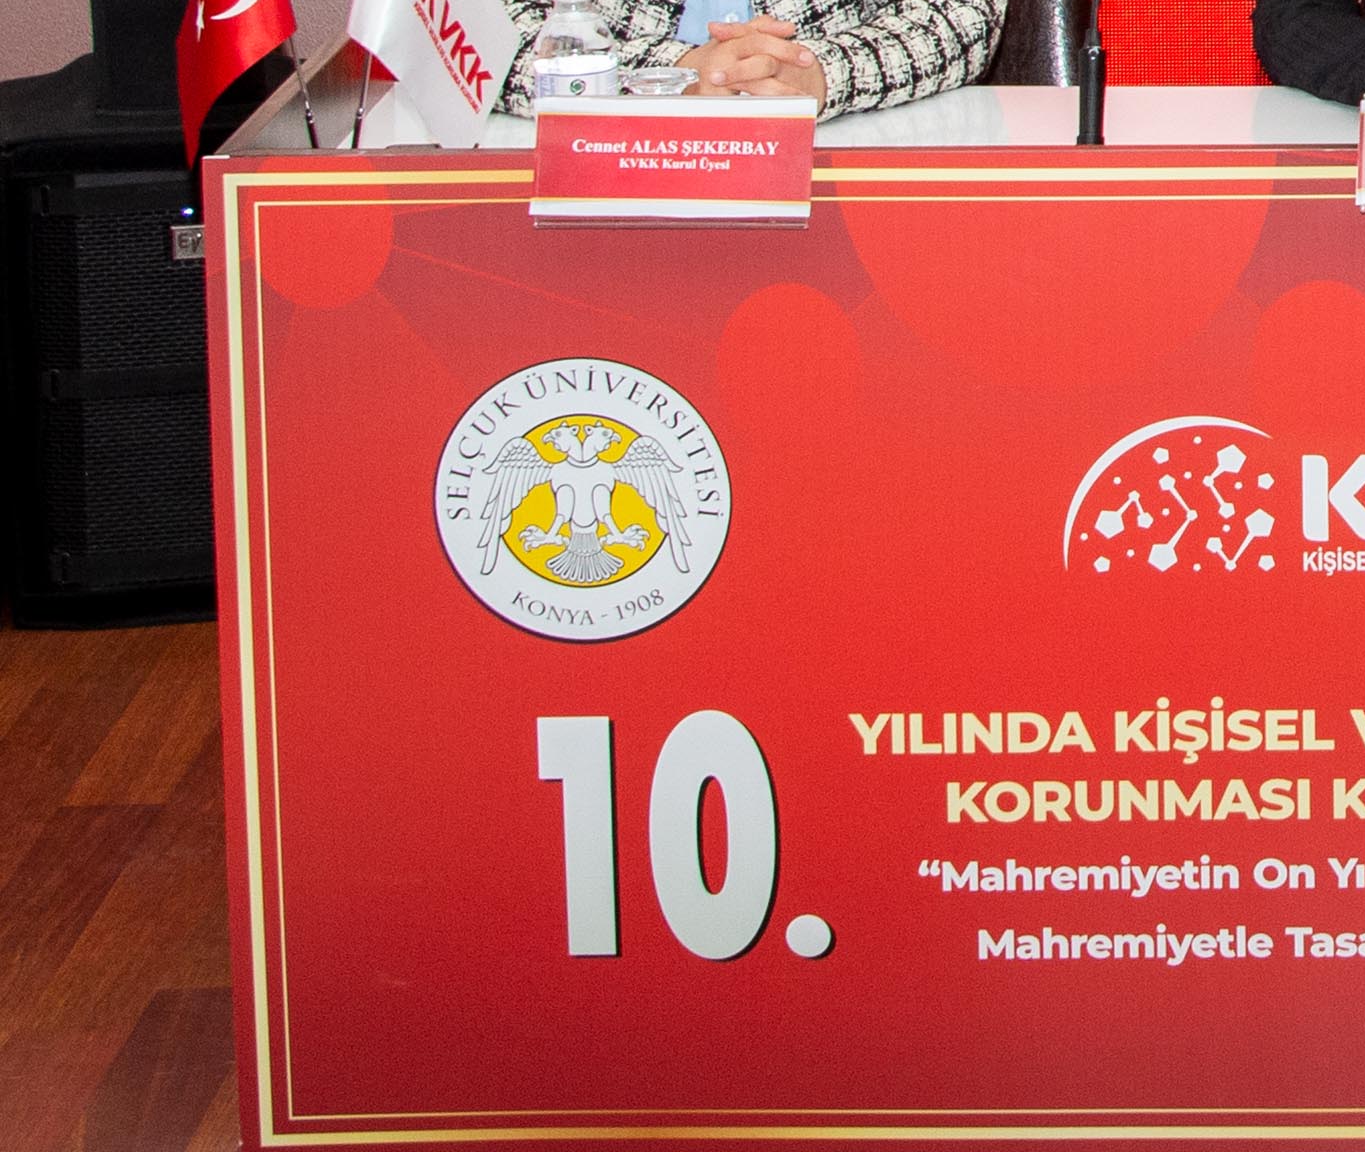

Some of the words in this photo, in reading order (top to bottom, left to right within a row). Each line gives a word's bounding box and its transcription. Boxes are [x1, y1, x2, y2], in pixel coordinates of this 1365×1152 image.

[572, 139, 627, 153] Cennet
[631, 140, 678, 153] ALAS
[682, 141, 779, 156] ŞEKERBAY
[619, 158, 659, 169] KVKK
[662, 159, 696, 169] Kurul
[699, 157, 730, 172] Üyesi
[447, 392, 521, 521] SELÇUK
[523, 365, 724, 520] ÜNİVERSİTESİ
[511, 591, 595, 625] KONYA
[614, 589, 666, 621] 1908
[849, 712, 1096, 754] YILINDA
[1115, 696, 1335, 764] KİŞİSEL
[947, 779, 1310, 822] KORUNMASI
[537, 710, 831, 959] 10.
[919, 855, 1239, 897] “Mahremiyetin
[1254, 858, 1315, 889] On
[978, 924, 1273, 966] Mahremiyetle
